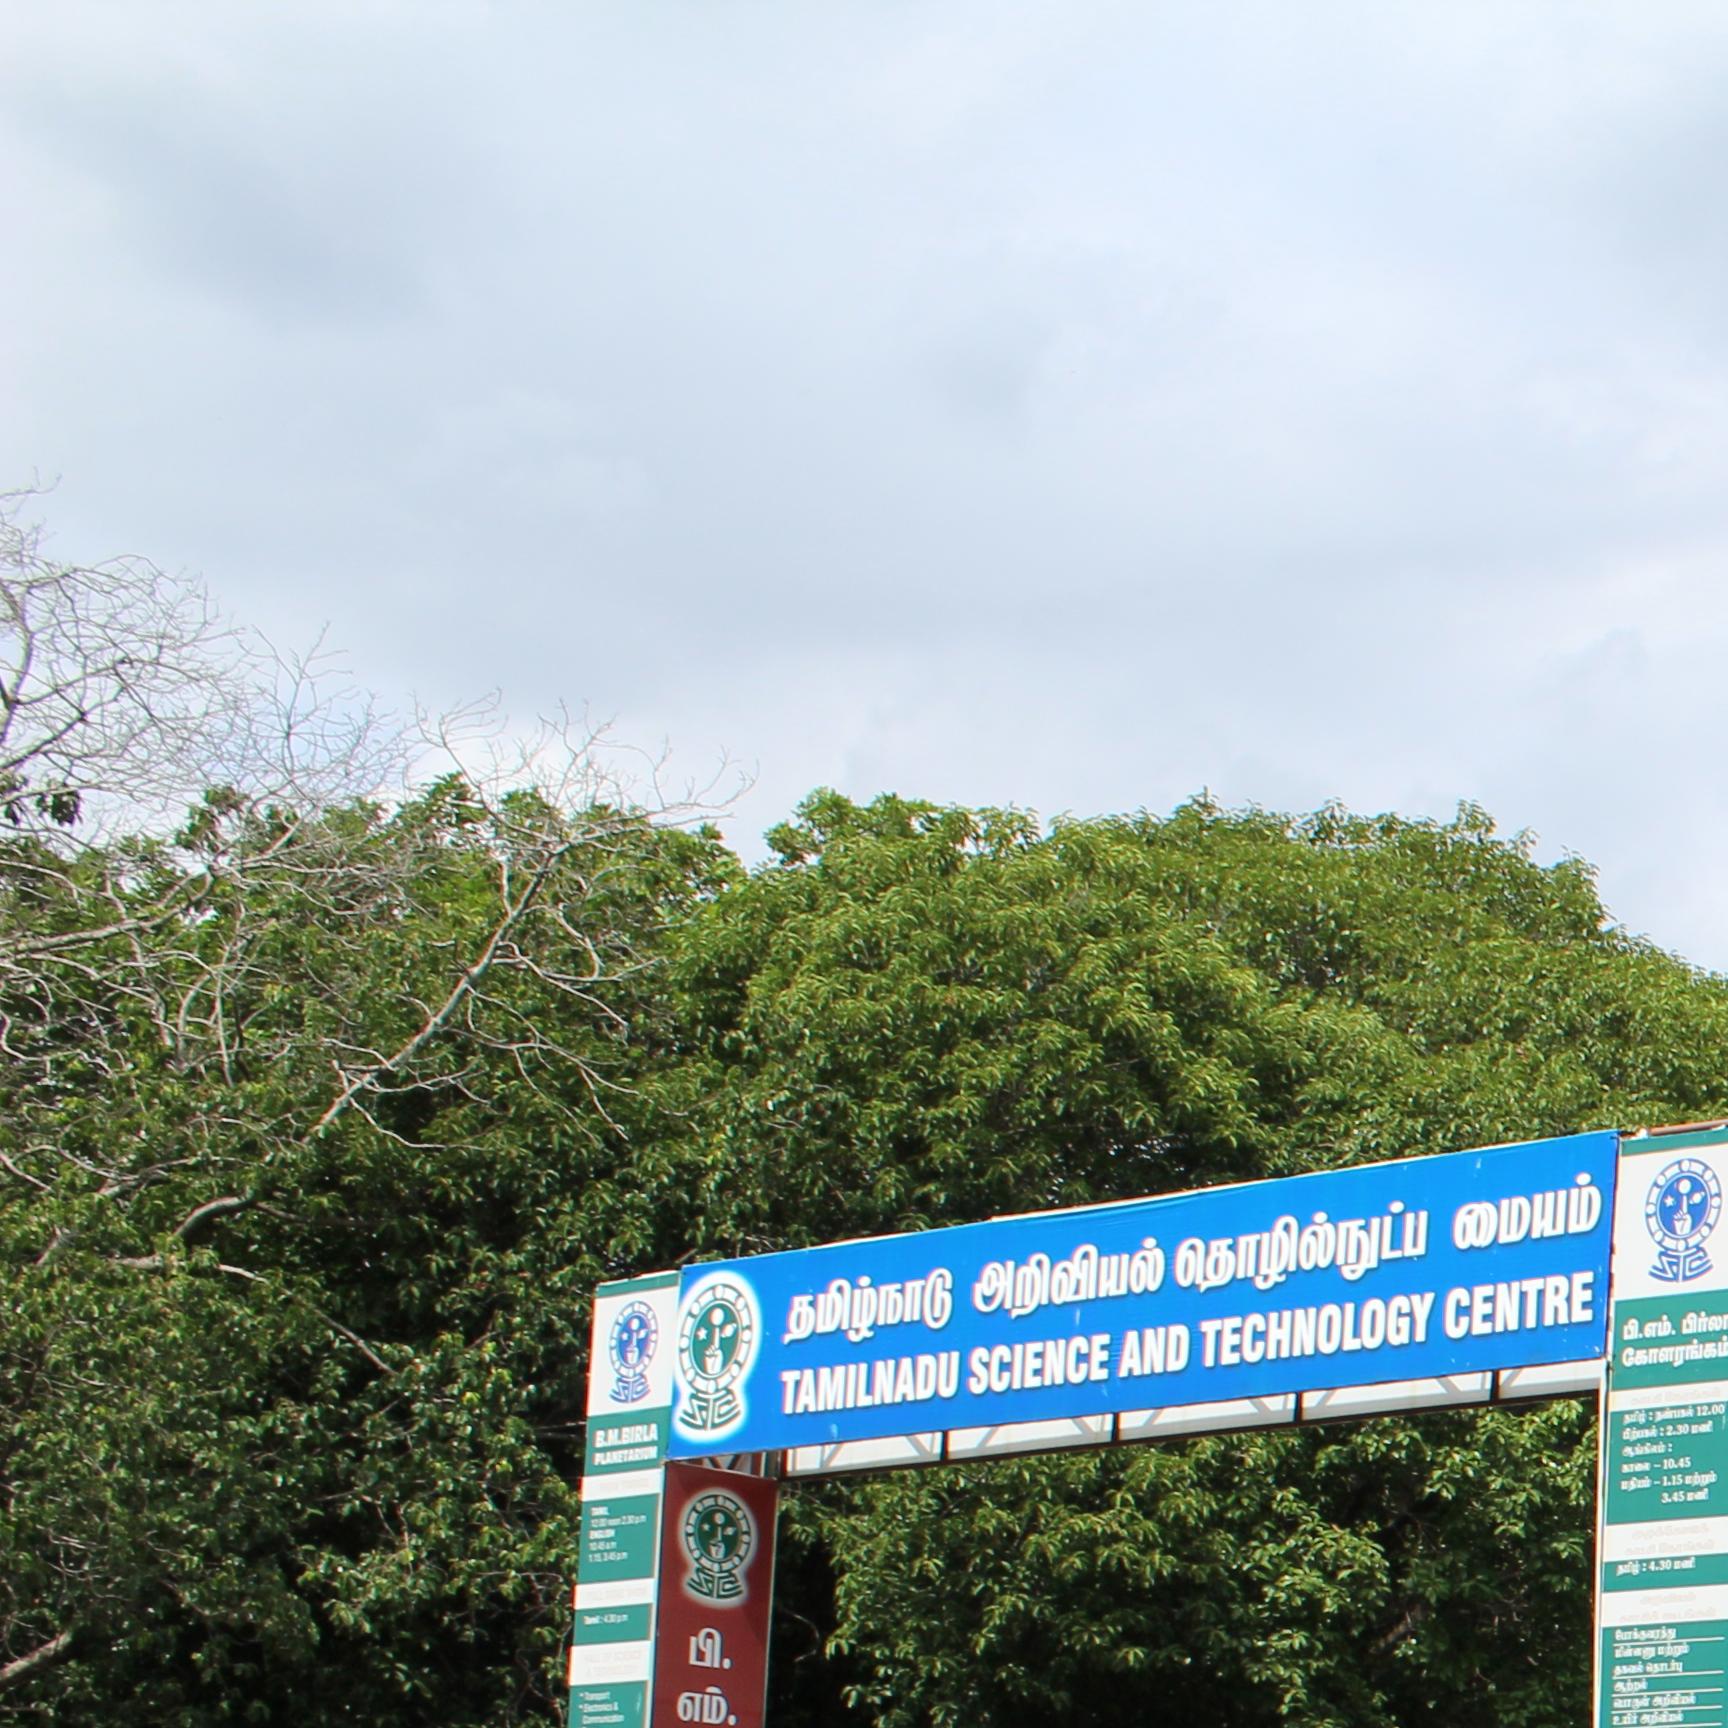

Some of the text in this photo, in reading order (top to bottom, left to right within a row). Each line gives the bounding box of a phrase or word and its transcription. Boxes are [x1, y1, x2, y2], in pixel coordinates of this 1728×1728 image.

[783, 1172, 1602, 1344] தமிழ்நாடு அறிவியல் தொழில்நுட்ப மையம்
[781, 1271, 1596, 1414] TAMILNADU SCIENCE AND TECHNOLOGY CENTRE
[1696, 1404, 1725, 1416] 12.00
[1665, 1424, 1689, 1436] 2.30
[1663, 1457, 1691, 1469] 10.45
[1661, 1491, 1685, 1504] 3.45
[1648, 1559, 1671, 1571] 4.30
